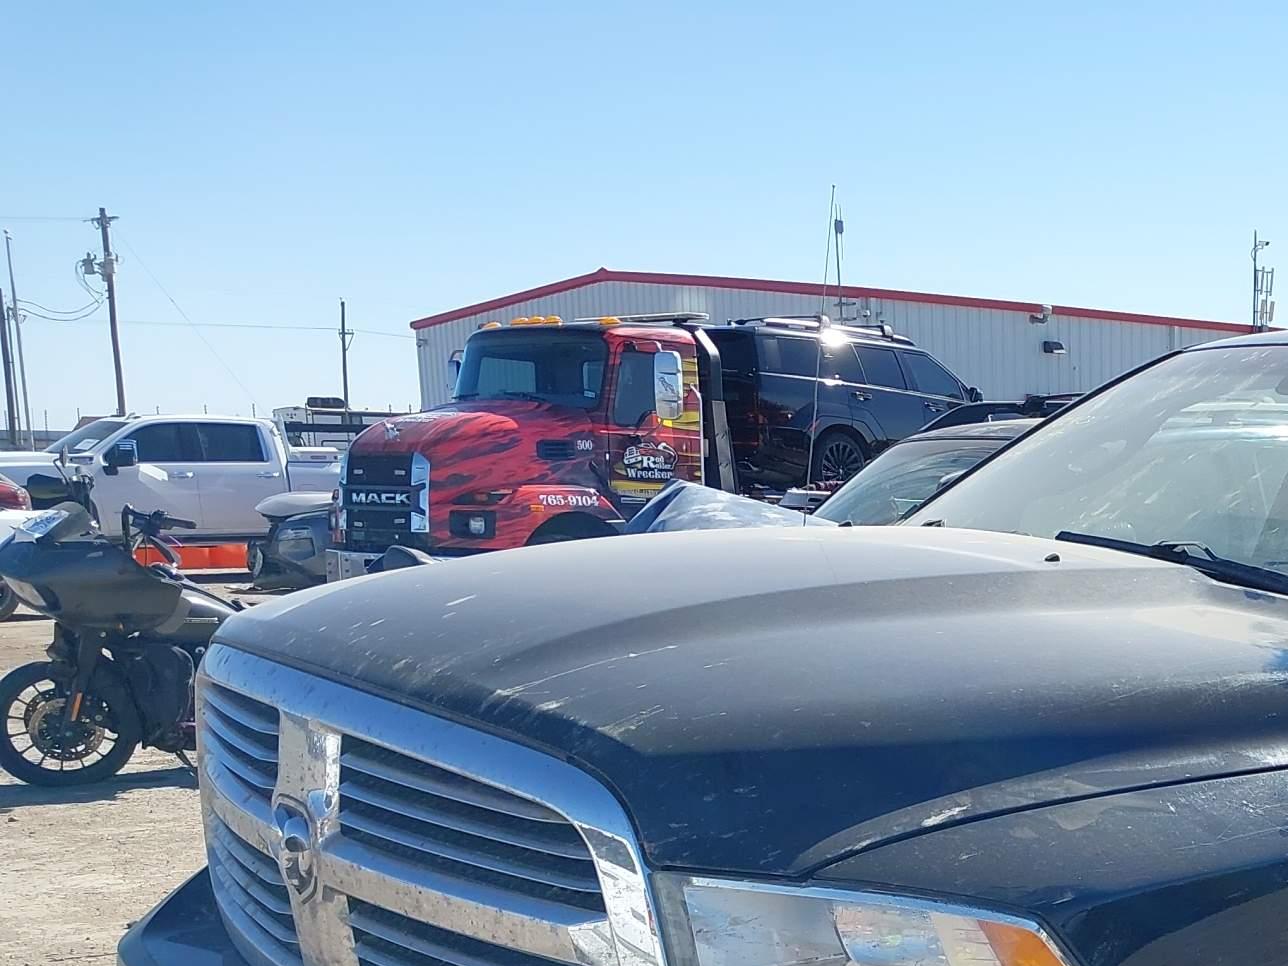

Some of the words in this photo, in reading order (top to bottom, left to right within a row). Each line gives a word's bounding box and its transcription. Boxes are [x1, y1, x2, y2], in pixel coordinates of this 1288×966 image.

[576, 440, 593, 450] 500
[626, 468, 673, 479] Wrecker
[351, 492, 411, 504] MACK
[538, 494, 599, 507] 765-9104
